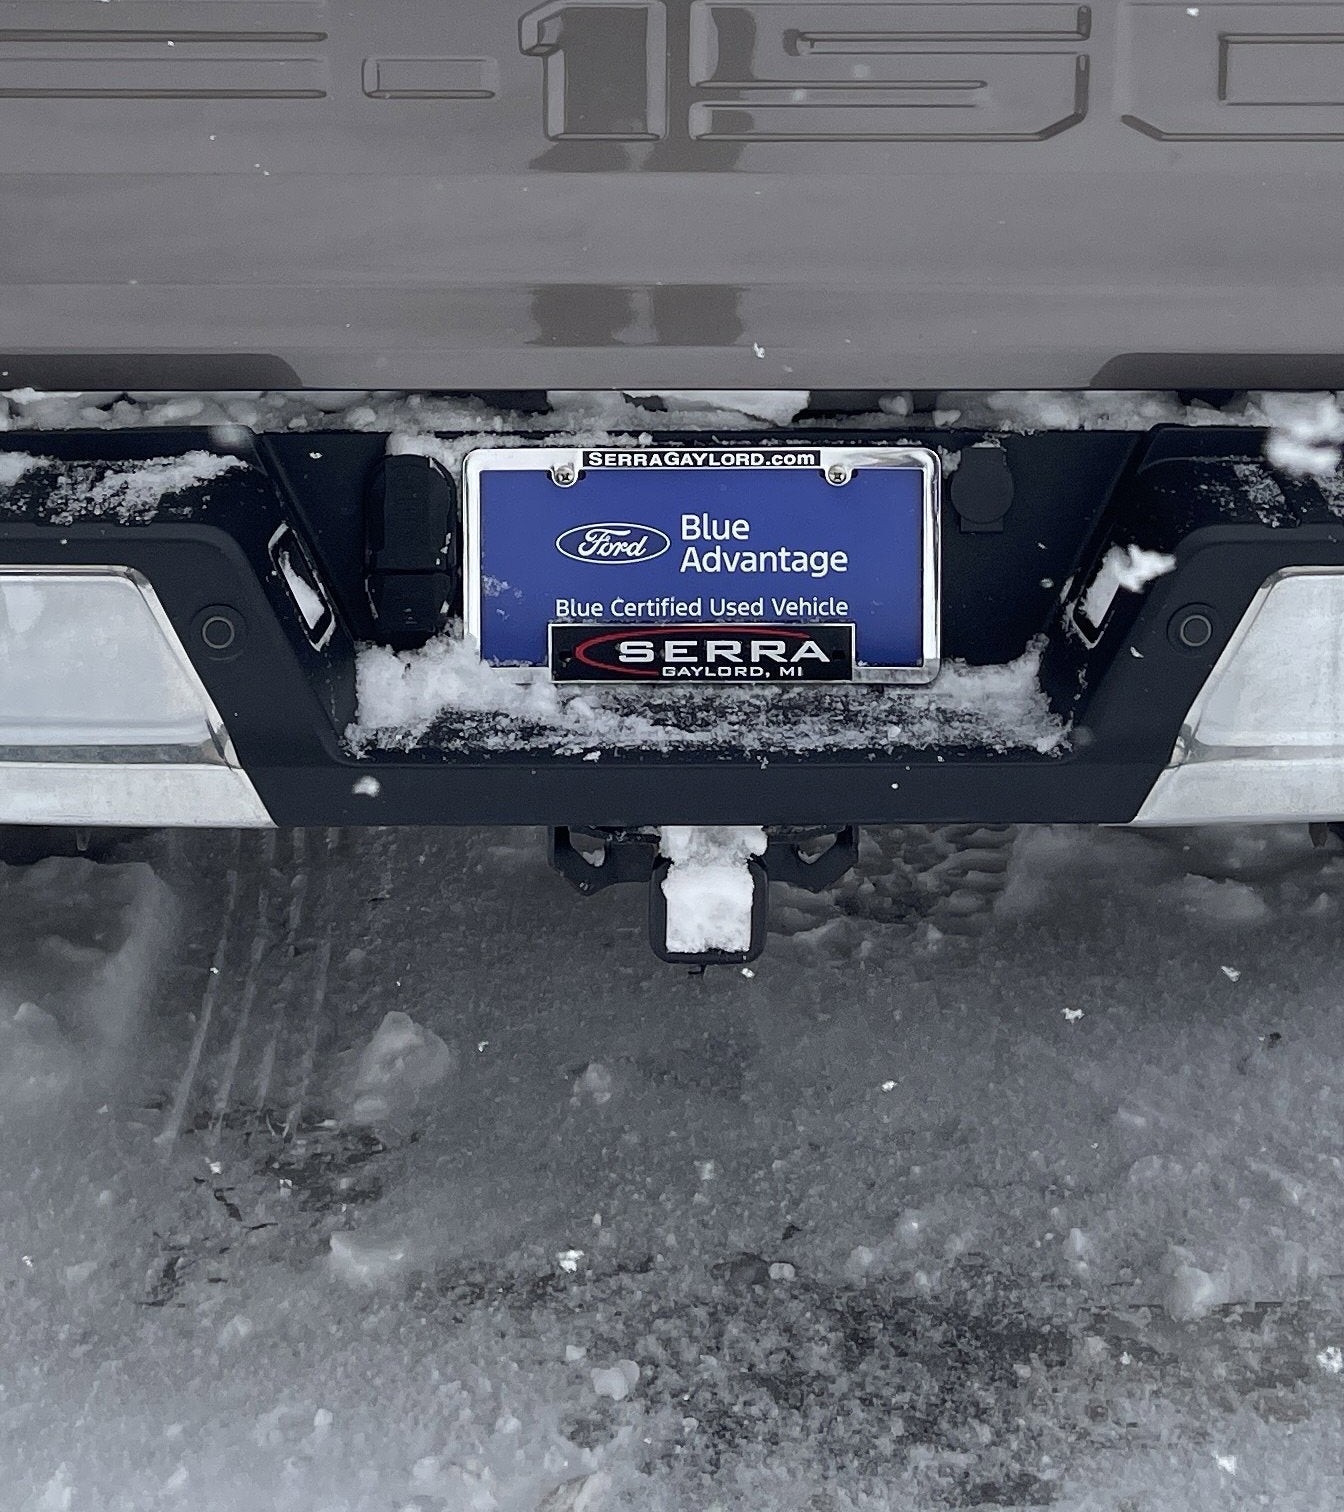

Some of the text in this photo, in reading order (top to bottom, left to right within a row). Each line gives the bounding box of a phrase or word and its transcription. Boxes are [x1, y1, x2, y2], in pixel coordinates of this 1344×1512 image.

[588, 451, 815, 467] SERRAGAYLORD.com
[681, 513, 750, 540] Blue
[576, 527, 649, 558] Ford
[680, 545, 848, 577] Advantage
[555, 597, 848, 617] Blue Certified Used Vehicle
[618, 640, 830, 663] SERRA
[662, 666, 803, 679] GAYLORD, MI
